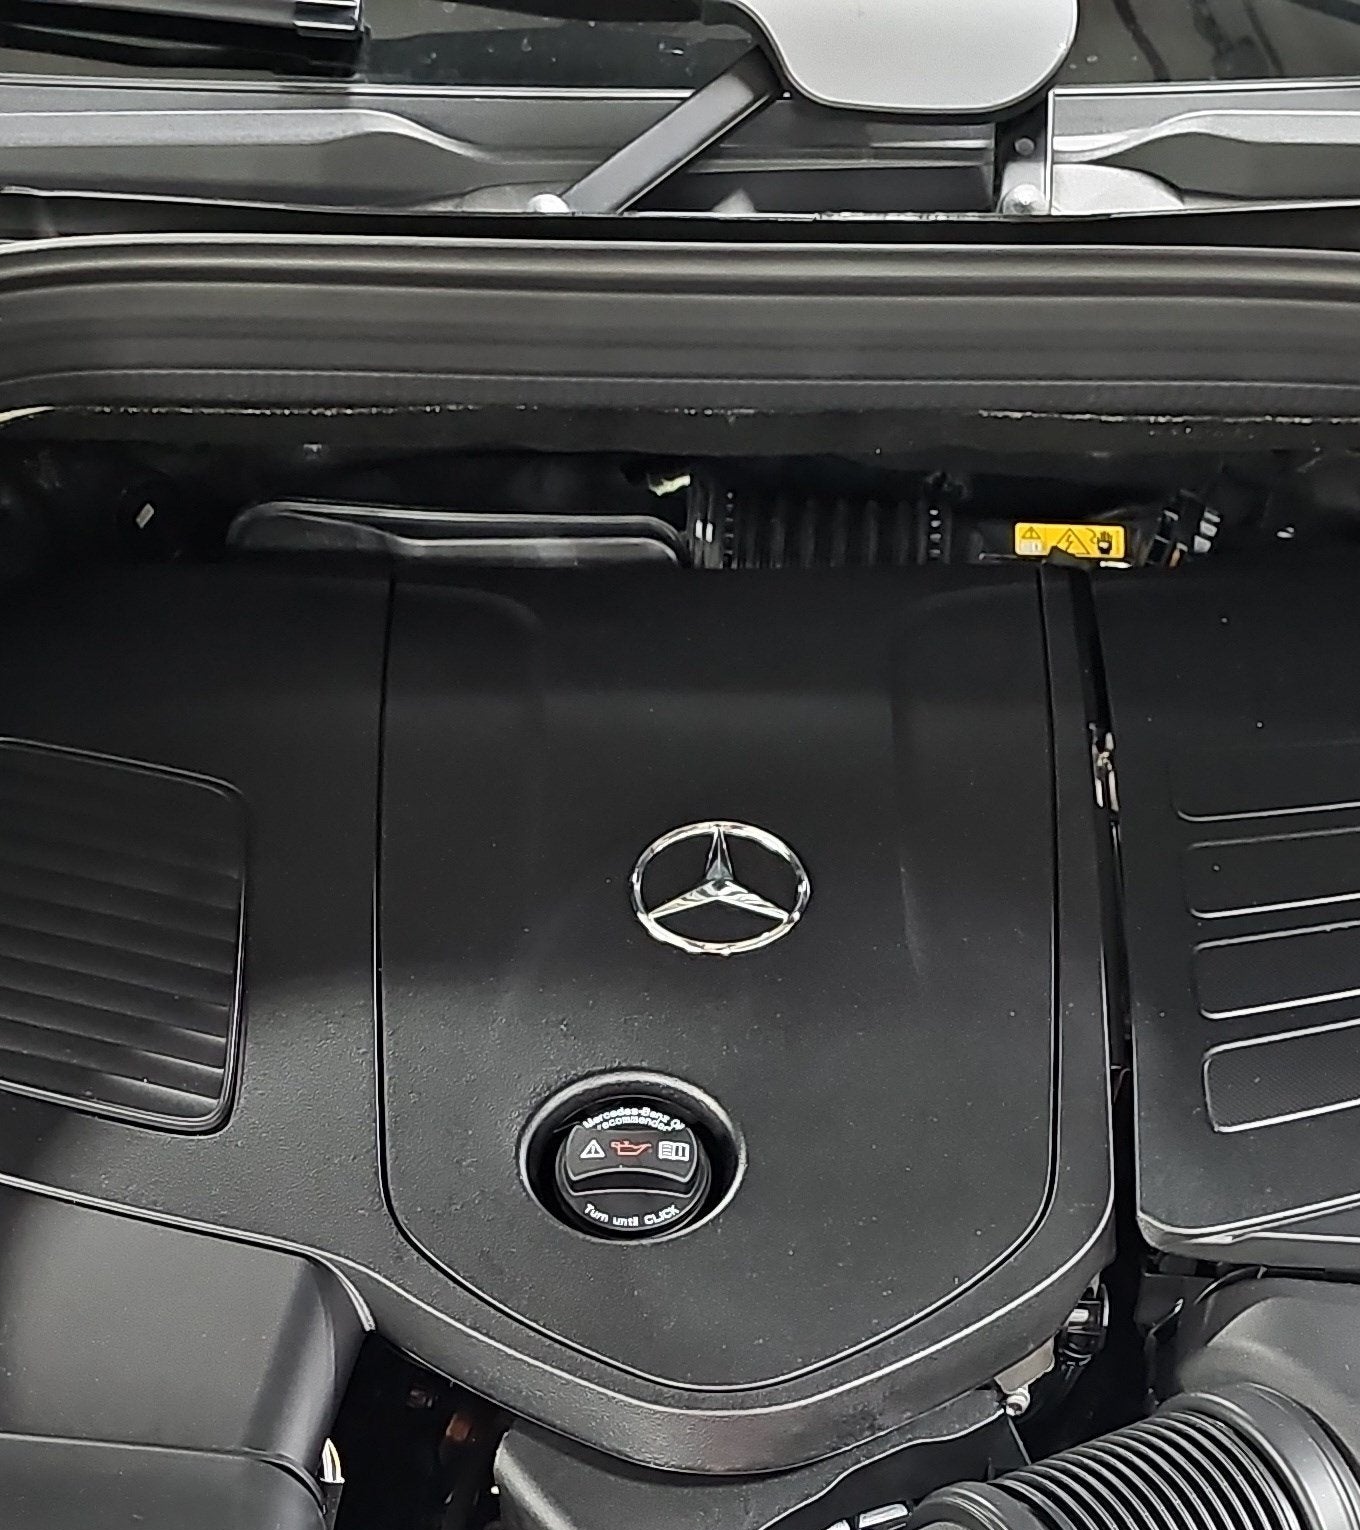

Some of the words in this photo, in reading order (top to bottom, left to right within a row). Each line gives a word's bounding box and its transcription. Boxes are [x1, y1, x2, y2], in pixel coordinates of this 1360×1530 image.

[582, 1107, 671, 1128] Mercedes-Benz
[584, 1203, 609, 1223] Turn
[612, 1216, 639, 1227] until
[643, 1204, 680, 1225] CLICK
